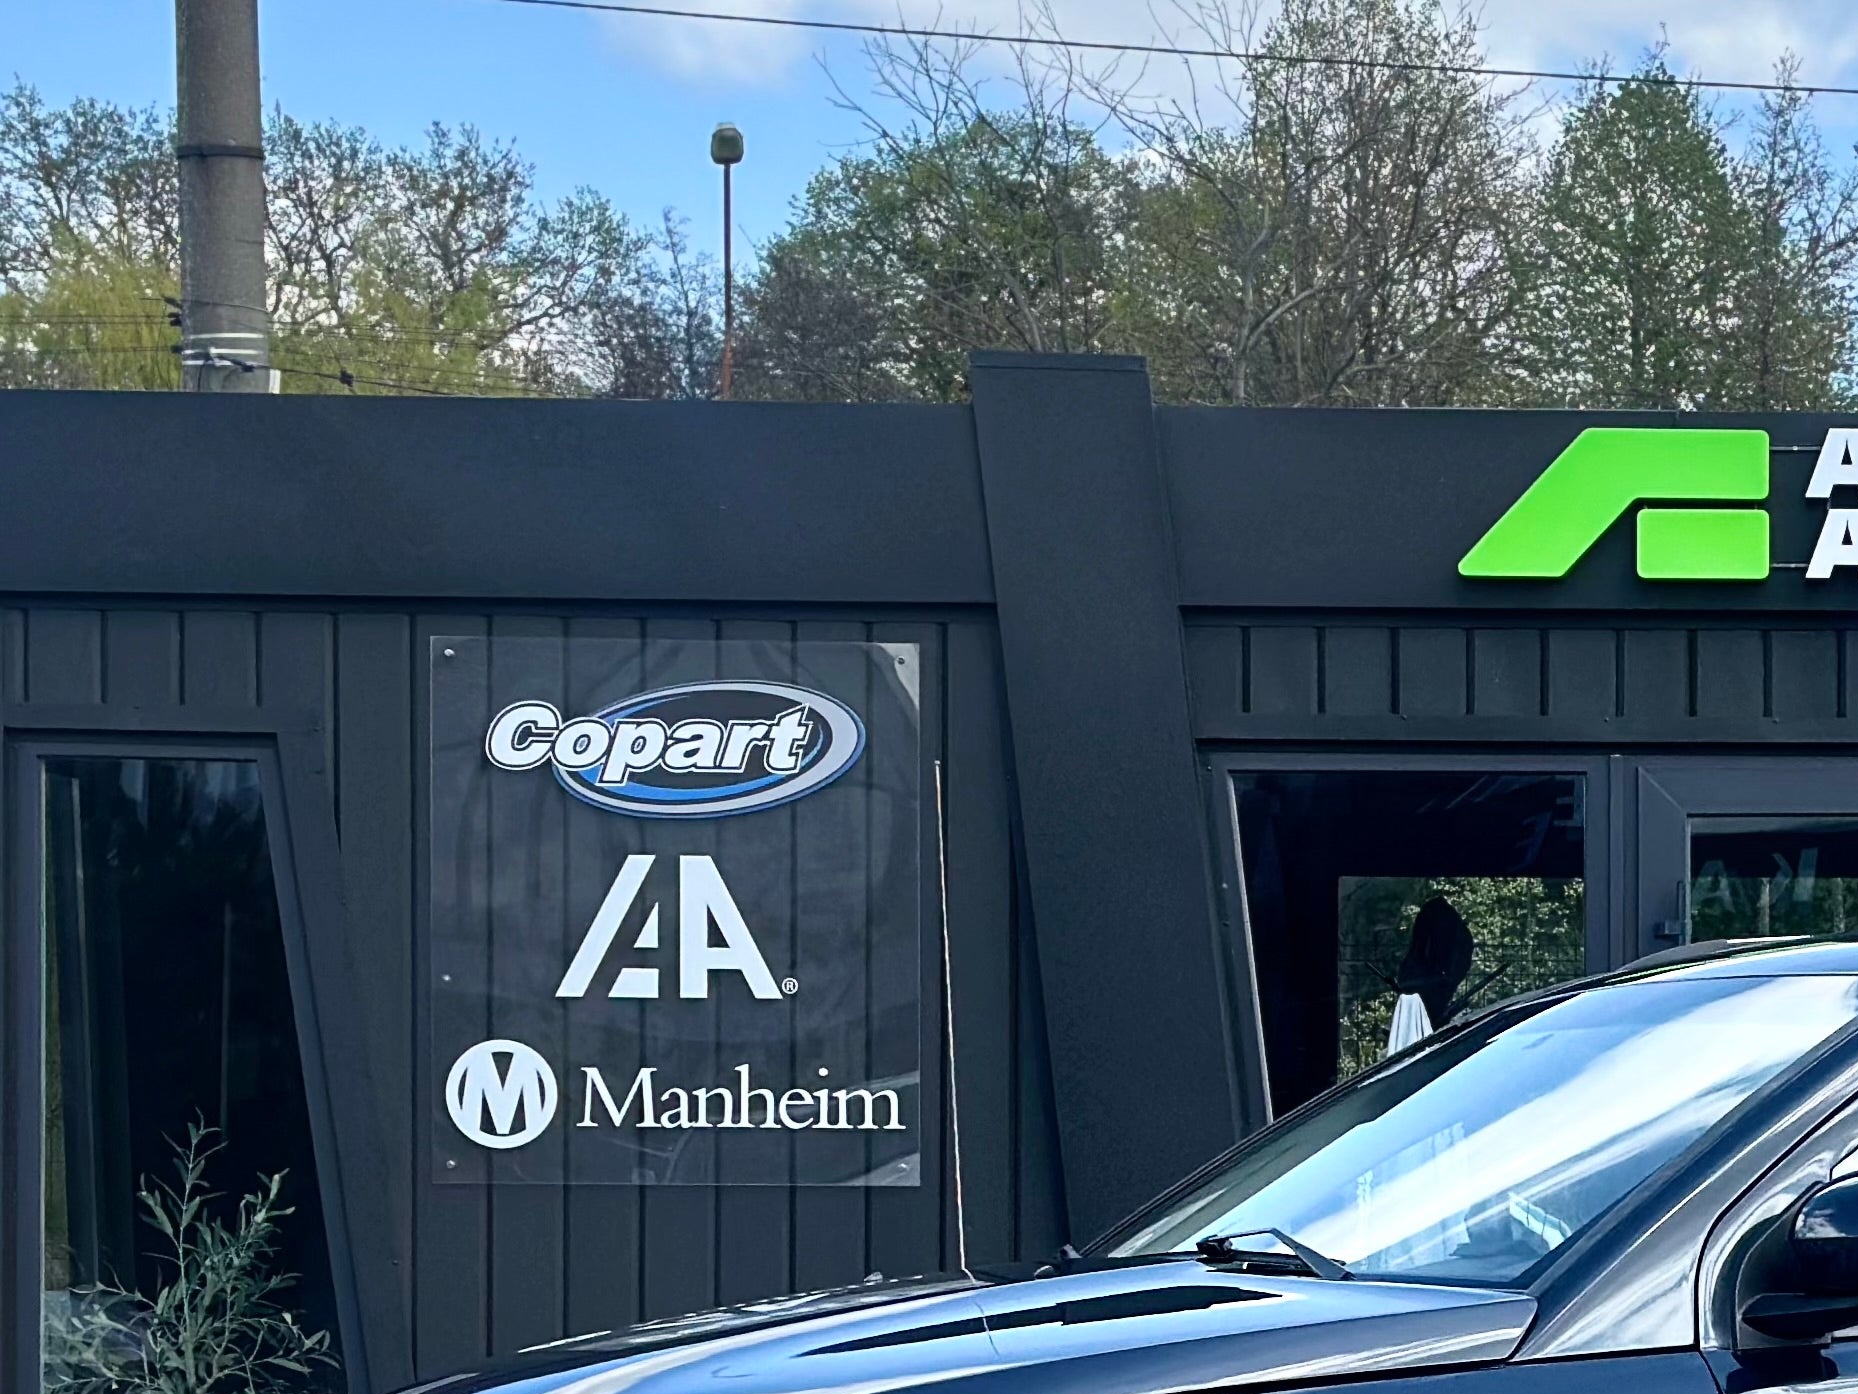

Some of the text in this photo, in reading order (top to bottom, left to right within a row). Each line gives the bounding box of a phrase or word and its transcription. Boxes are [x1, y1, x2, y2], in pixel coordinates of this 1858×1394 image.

[486, 700, 812, 787] Copart
[446, 1040, 906, 1149] M Manheim
